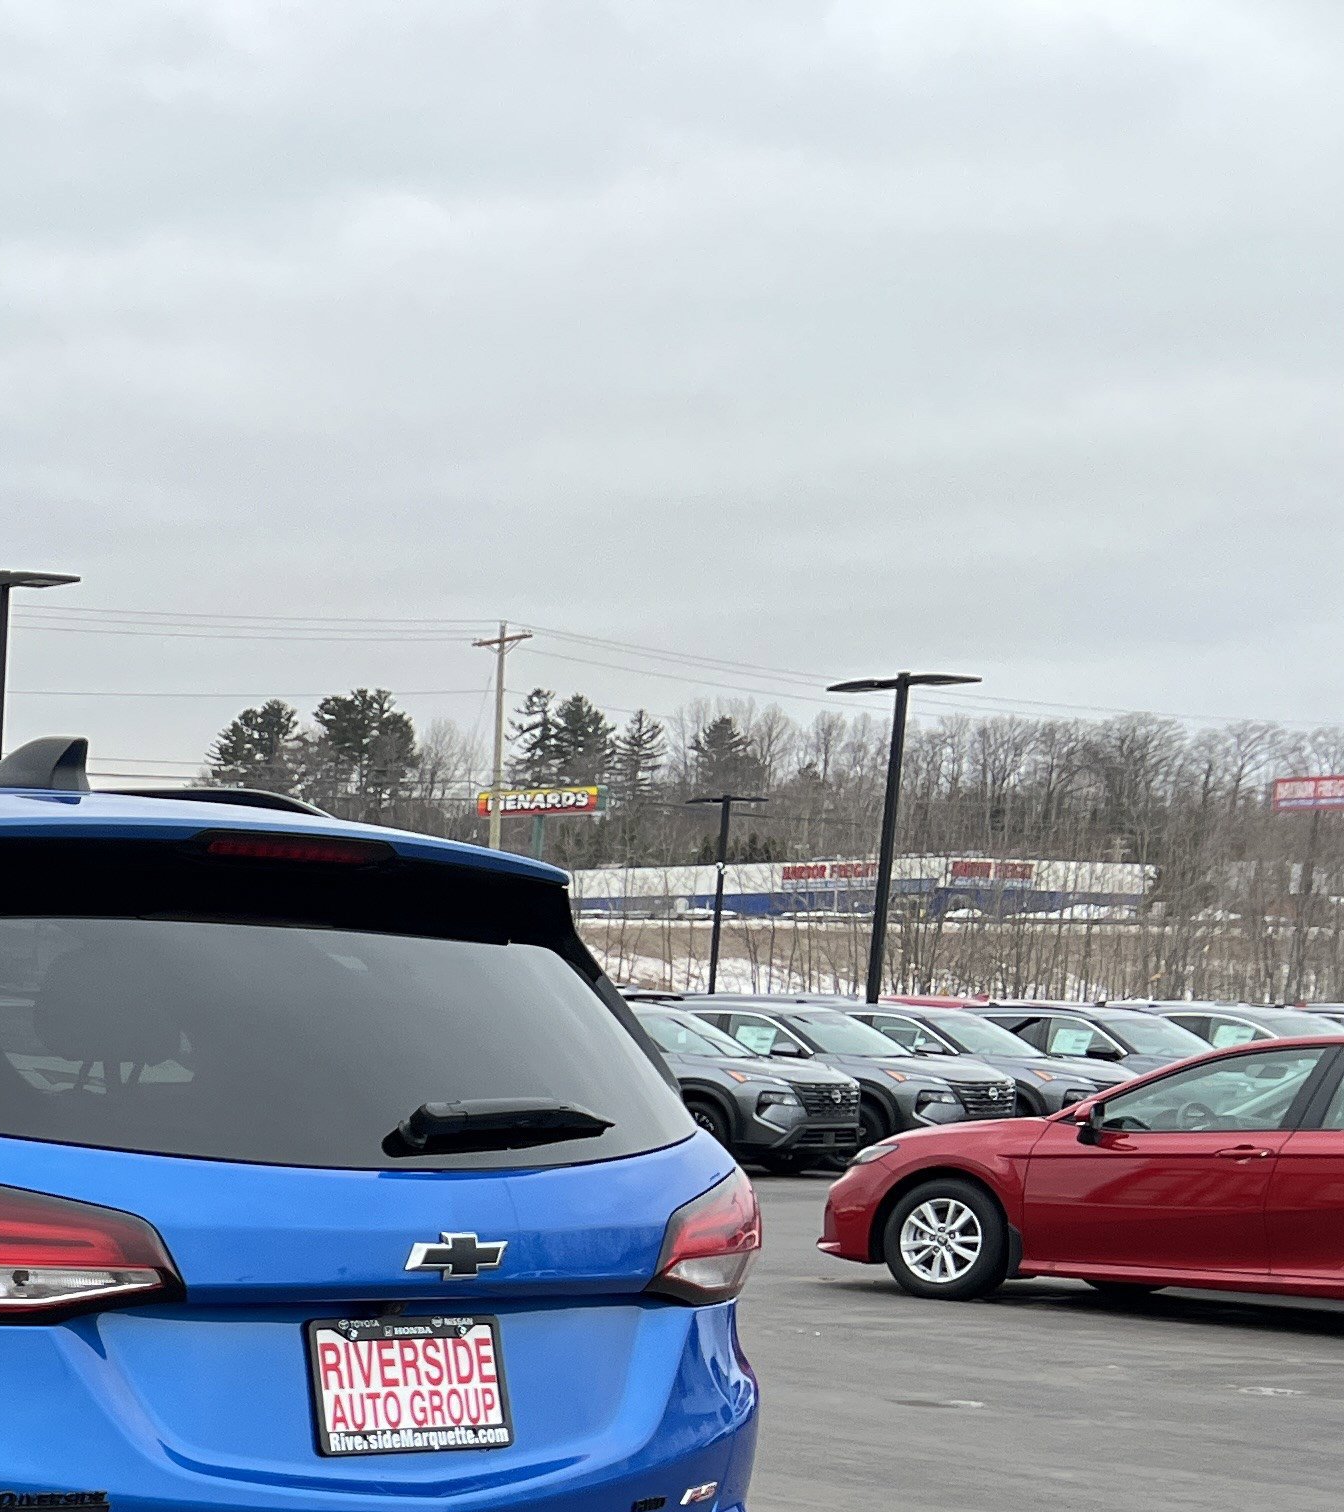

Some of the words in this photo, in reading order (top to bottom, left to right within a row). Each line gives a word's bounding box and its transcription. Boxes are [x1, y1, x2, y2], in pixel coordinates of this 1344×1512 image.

[394, 1326, 433, 1335] HONDA
[319, 1338, 497, 1390] RIVERSIDE
[331, 1390, 403, 1432] AUTO
[410, 1388, 496, 1429] GROUP
[329, 1427, 510, 1452] RiversideMarquette.com
